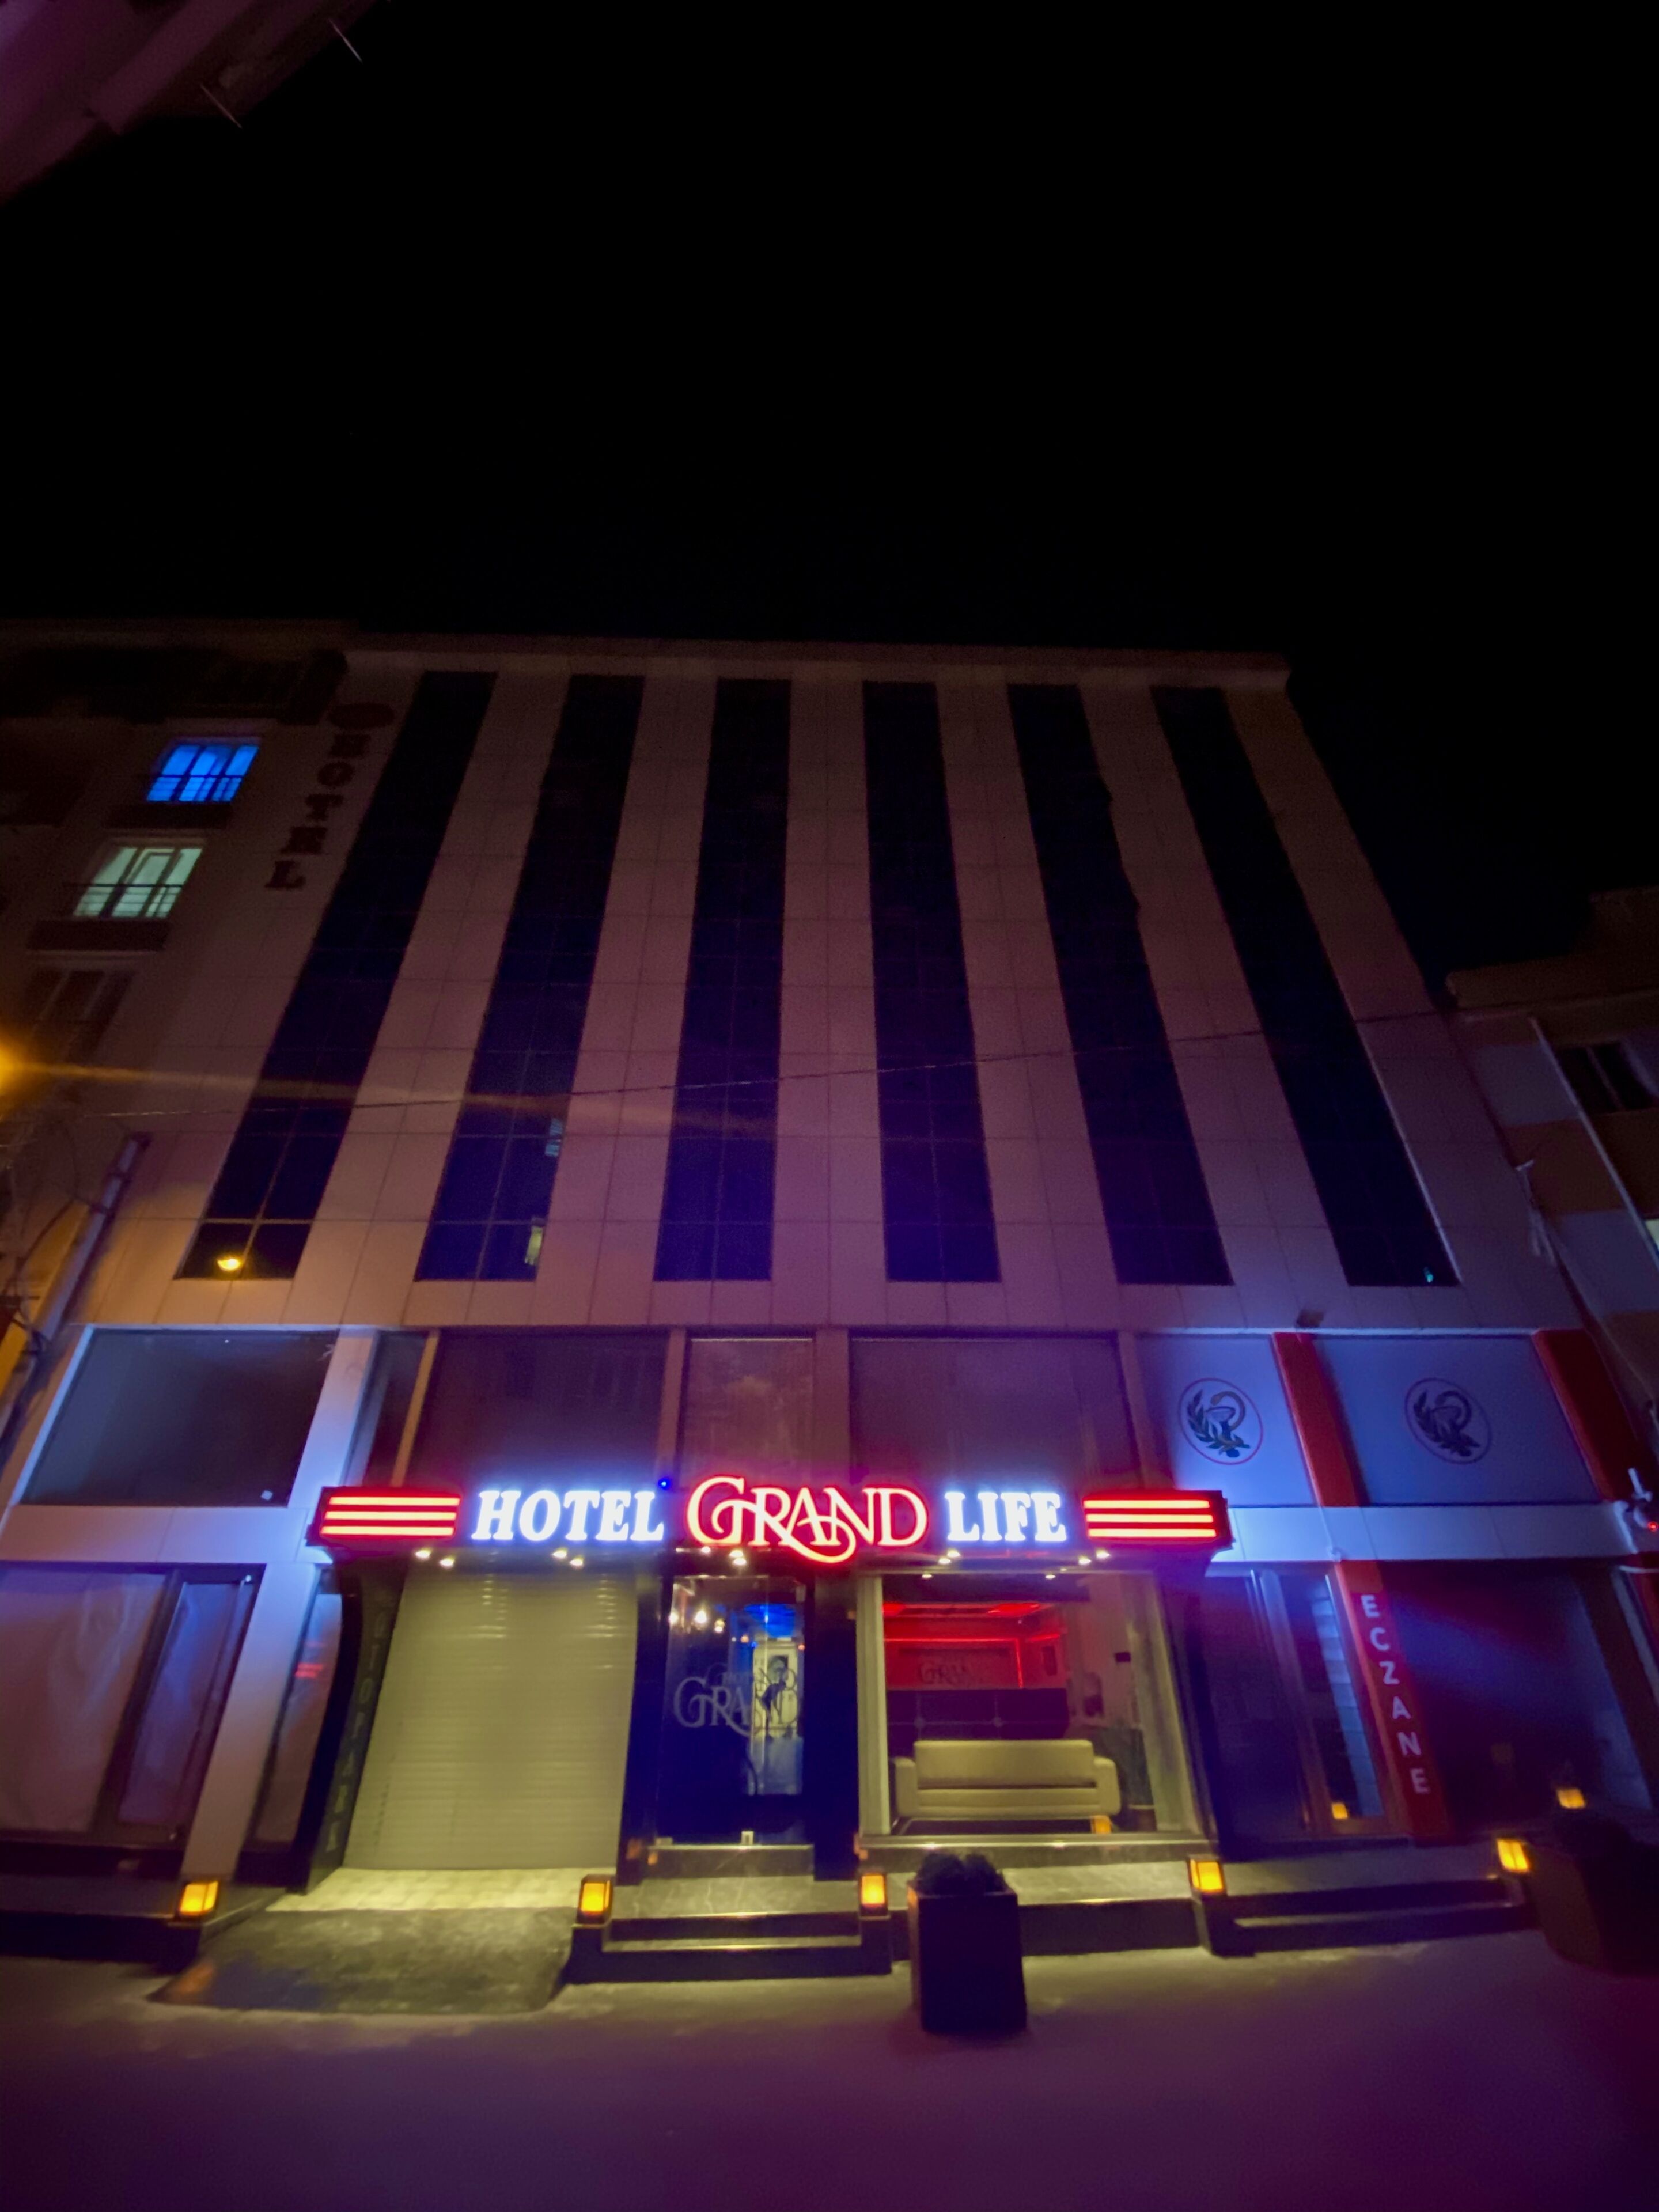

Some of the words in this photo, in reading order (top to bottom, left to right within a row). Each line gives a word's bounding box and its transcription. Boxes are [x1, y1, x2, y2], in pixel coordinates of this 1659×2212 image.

[264, 734, 370, 888] HOTEL
[471, 1490, 664, 1541] HOTEL
[687, 1475, 929, 1563] GRAND
[944, 1491, 1067, 1542] LIFE
[1360, 1594, 1430, 1794] ECZANE
